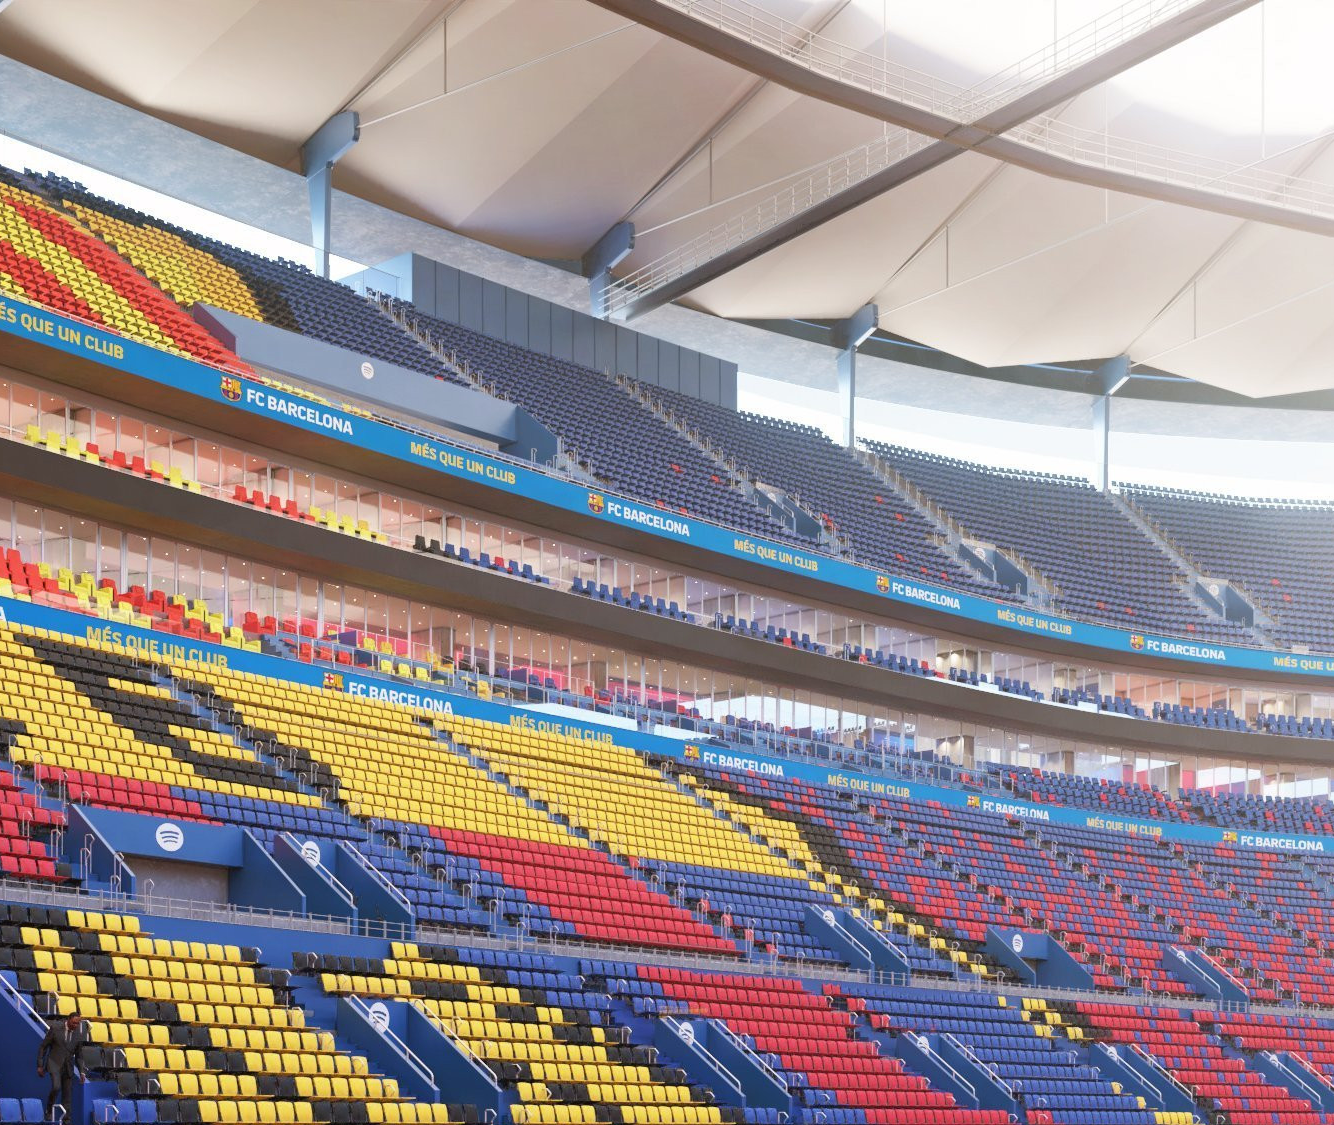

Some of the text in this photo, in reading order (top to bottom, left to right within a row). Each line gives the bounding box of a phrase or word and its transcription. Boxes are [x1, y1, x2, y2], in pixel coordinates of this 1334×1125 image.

[21, 313, 54, 336] QUE
[58, 325, 81, 345] UN
[84, 335, 124, 360] CLUB
[247, 389, 353, 435] FC BARCELONA
[410, 442, 516, 485] MÉS QUE UN CLUB
[607, 502, 690, 537] FC BARCELONA
[734, 539, 818, 572] MÉS QUE UN CLUB
[892, 582, 960, 610] FC BARCELONA
[997, 609, 1072, 635] MÉS QUE UN CLUB
[86, 625, 228, 667] MÉS QUE UN CLUB
[1147, 640, 1226, 661] FC BARCELONA
[1273, 656, 1298, 668] MÉS
[1300, 660, 1323, 671] QUE
[348, 681, 453, 714] FC BARCELONA
[509, 714, 613, 745] MÉS QUE UN CLUB
[703, 752, 784, 776] FC BARCELONA
[828, 774, 910, 798] MÉS QUE UN CLUB
[983, 800, 1050, 821] FC BARCELONA
[1086, 816, 1162, 837] MÉS QUE UN CLUB
[1241, 835, 1324, 851] FC BARCELONA
